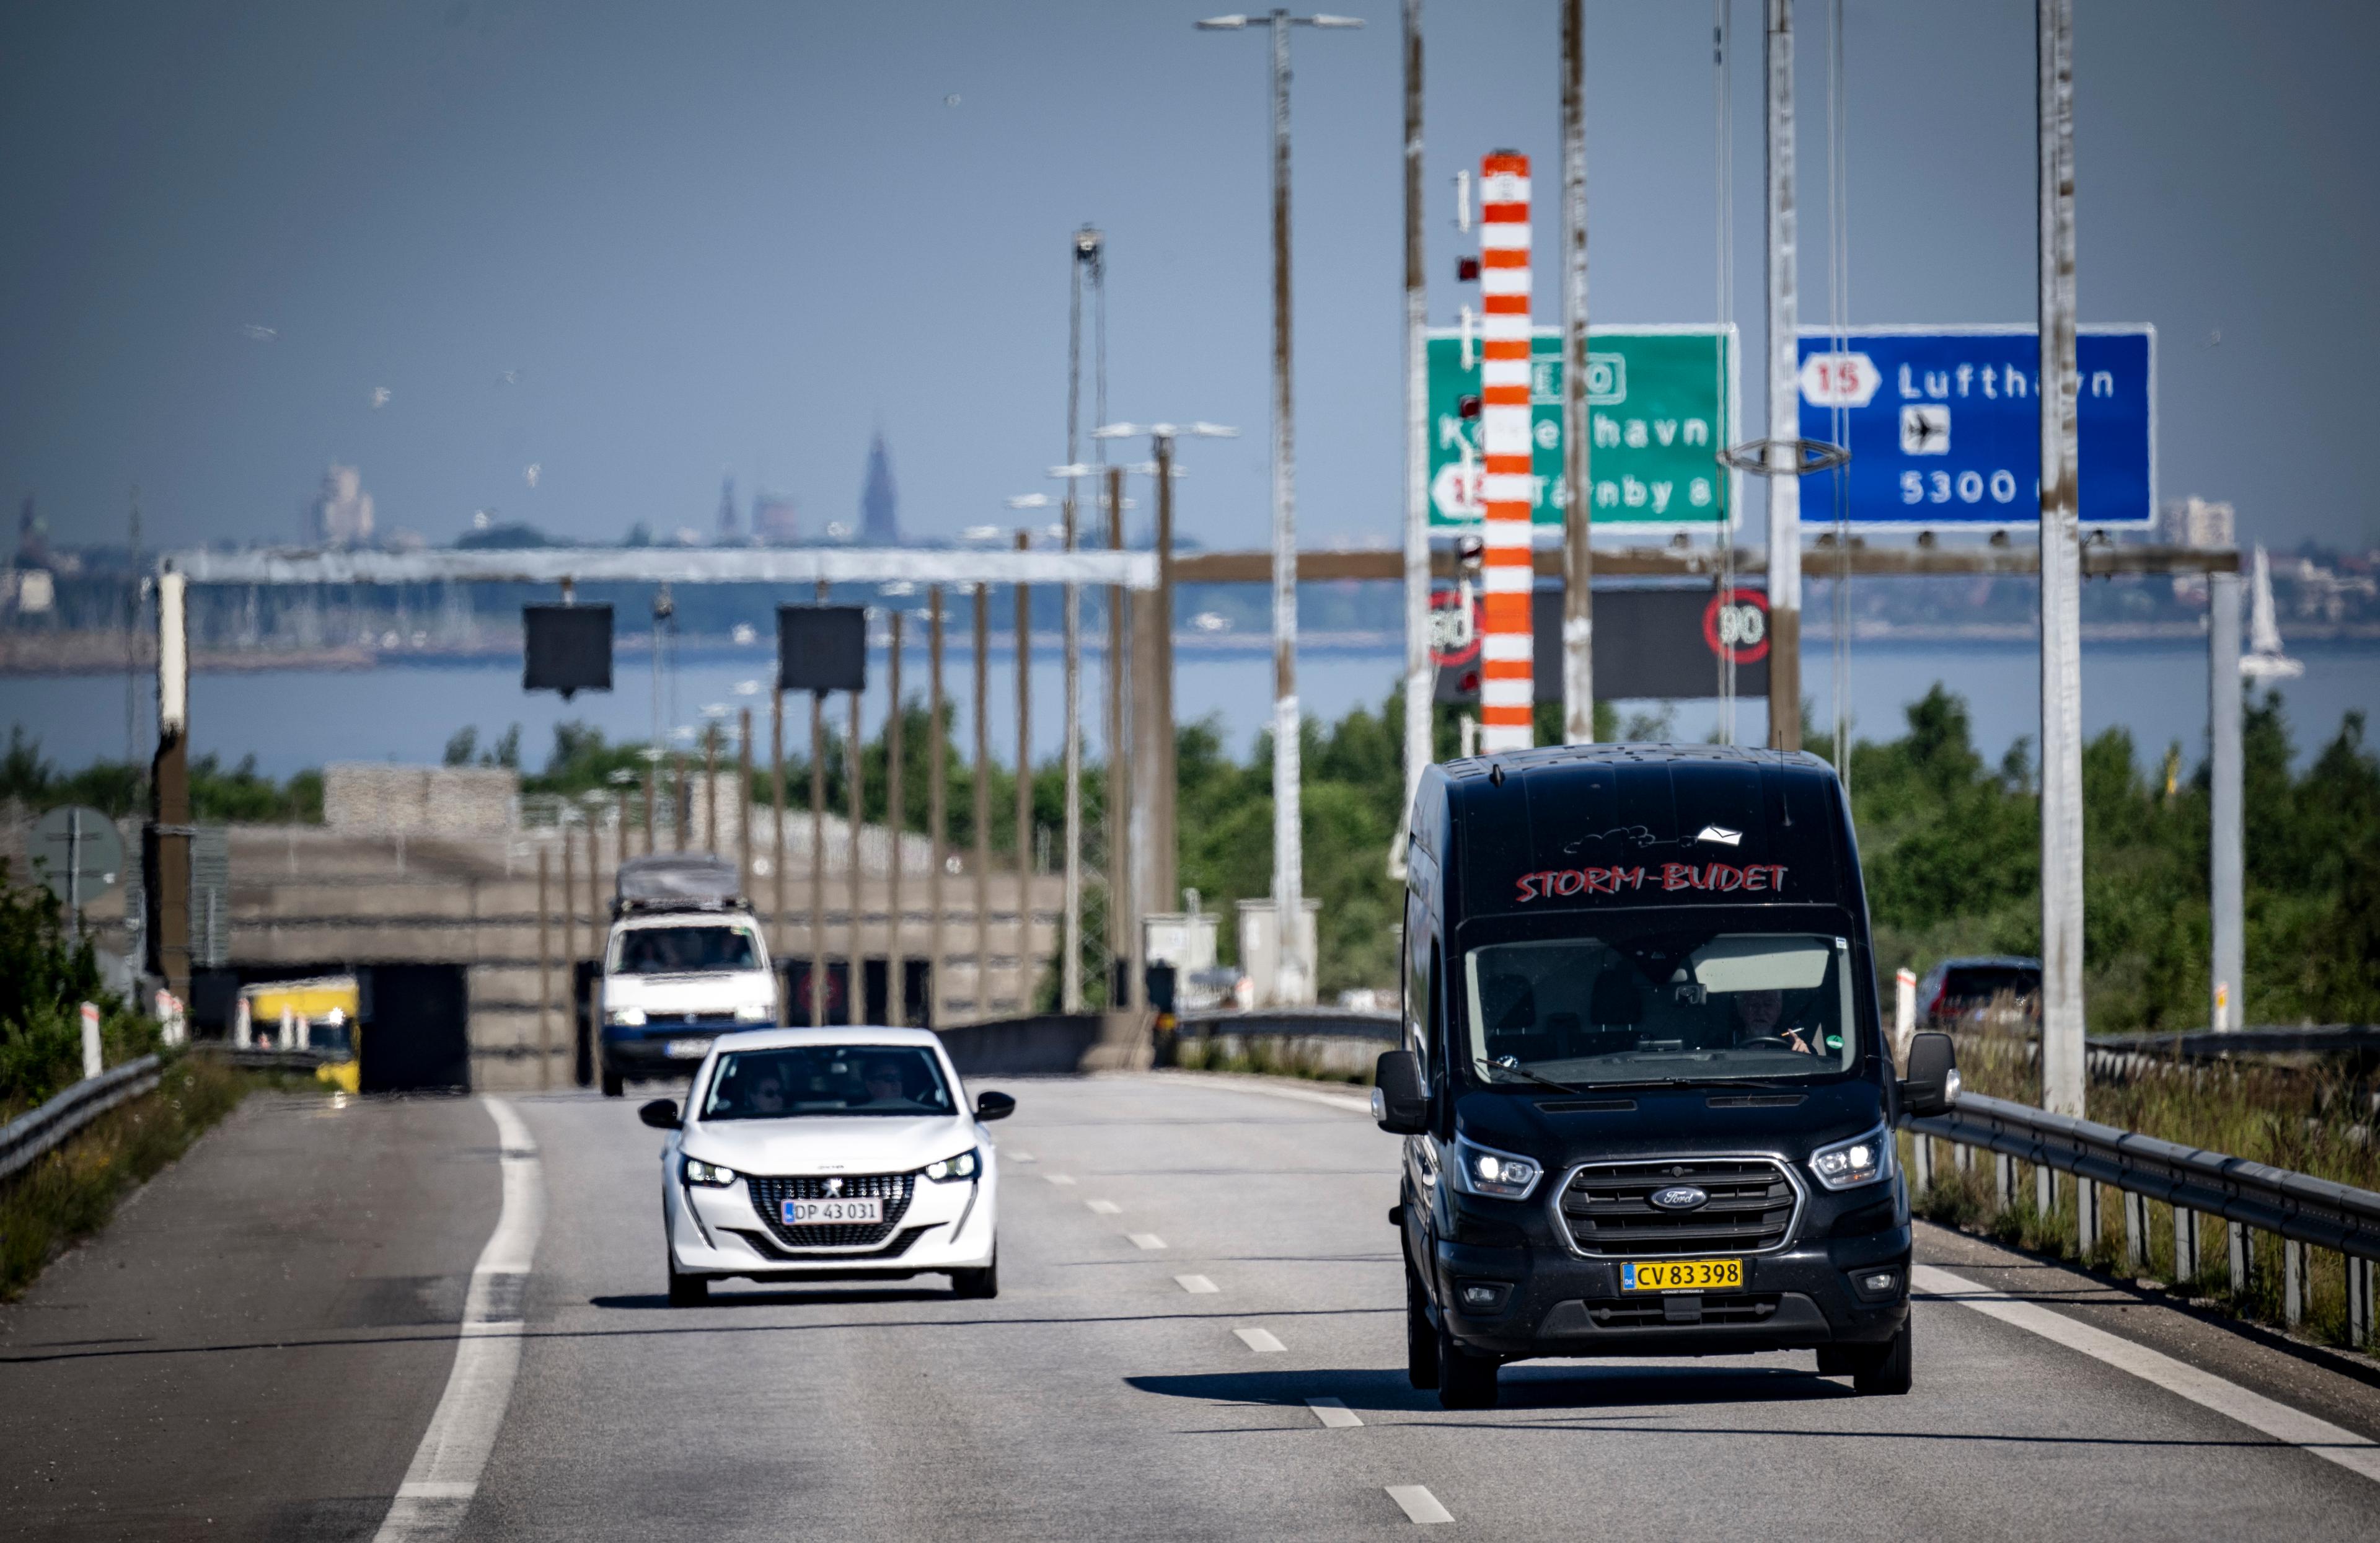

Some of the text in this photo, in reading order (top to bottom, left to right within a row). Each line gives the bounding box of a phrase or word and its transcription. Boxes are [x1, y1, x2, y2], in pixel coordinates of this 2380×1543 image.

[1534, 363, 1613, 395] E0
[1817, 363, 1859, 396] 15
[1898, 361, 2114, 398] Lufthn
[1438, 412, 1709, 450] Kehavn
[1900, 469, 2017, 505] 5300
[1516, 862, 1789, 902] STORM-BUDET
[795, 1204, 818, 1220] DP
[823, 1203, 843, 1219] 43
[848, 1203, 877, 1219] 031
[1664, 1190, 1693, 1205] Ford
[1637, 1267, 1664, 1286] CV
[1670, 1265, 1695, 1285] 83
[1701, 1263, 1739, 1283] 398
